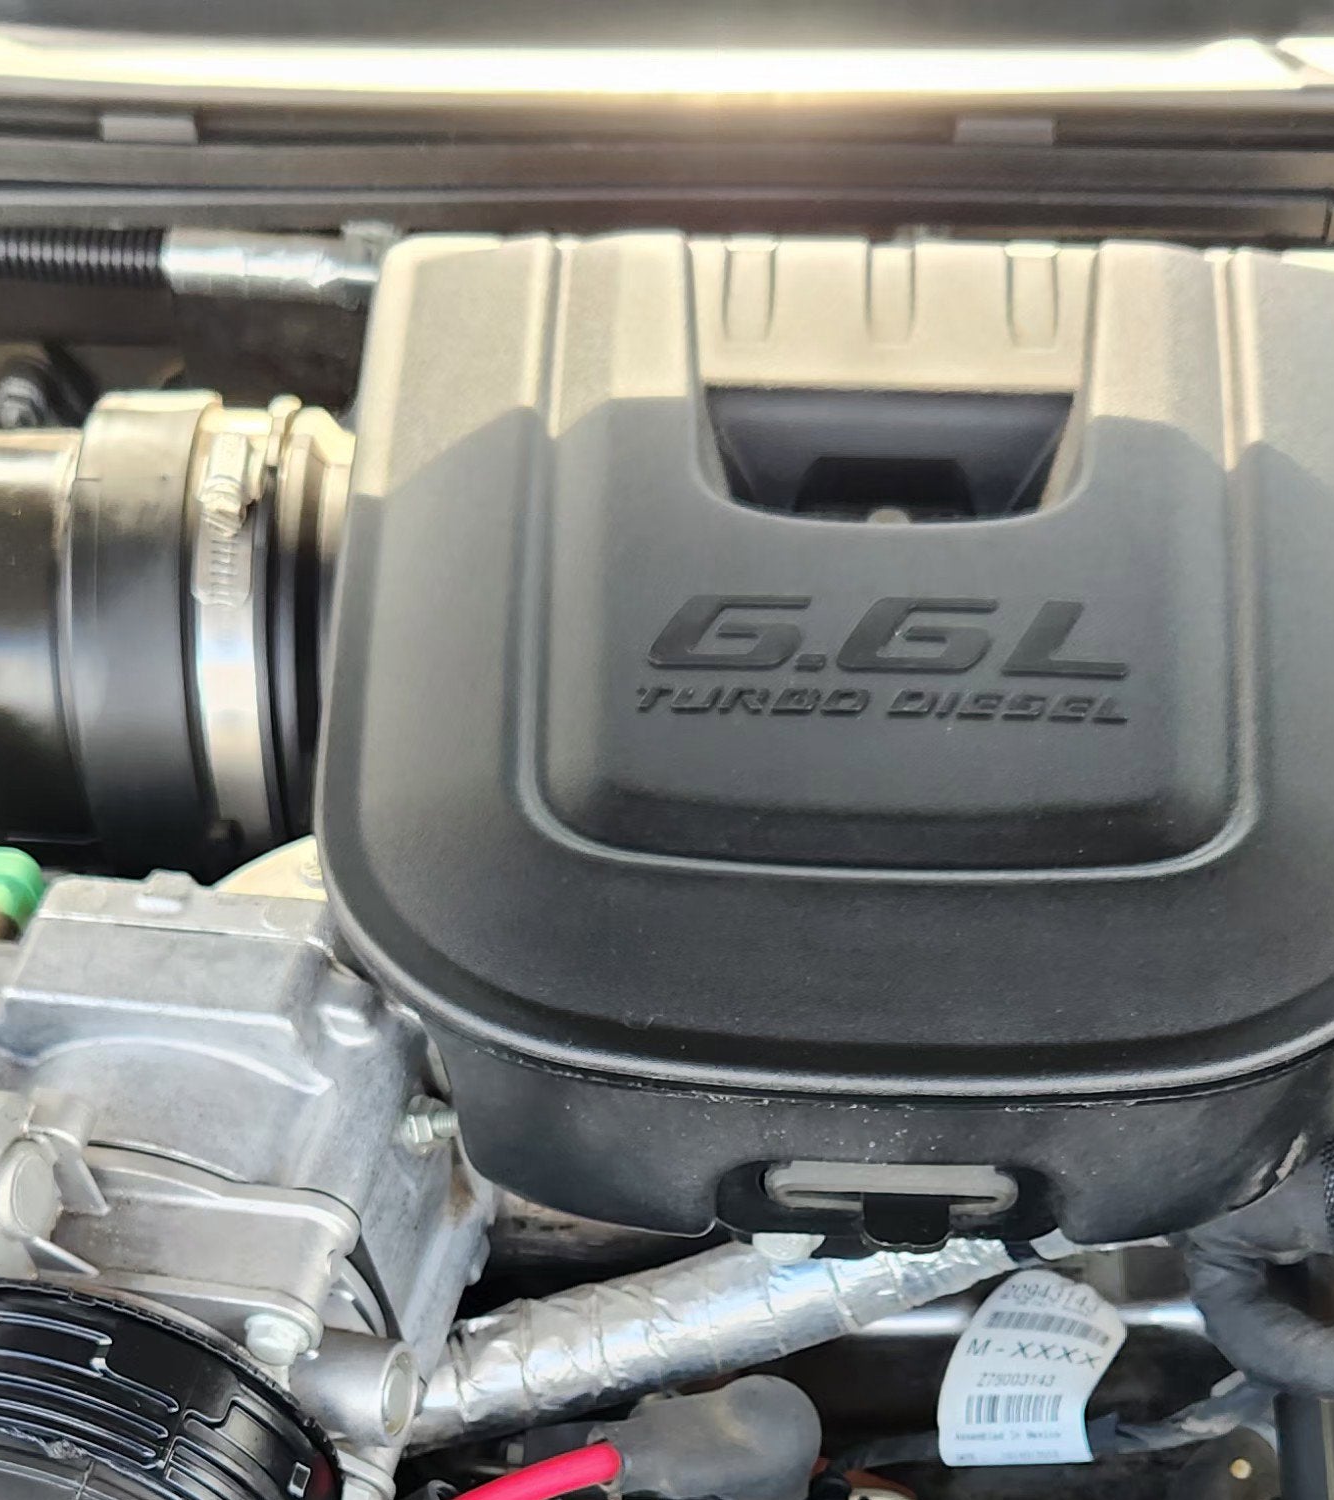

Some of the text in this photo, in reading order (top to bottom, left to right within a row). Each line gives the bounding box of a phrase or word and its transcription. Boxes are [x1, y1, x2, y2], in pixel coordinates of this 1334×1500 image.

[647, 594, 1130, 680] 6.6L
[636, 686, 1130, 724] TURBO DIESEL
